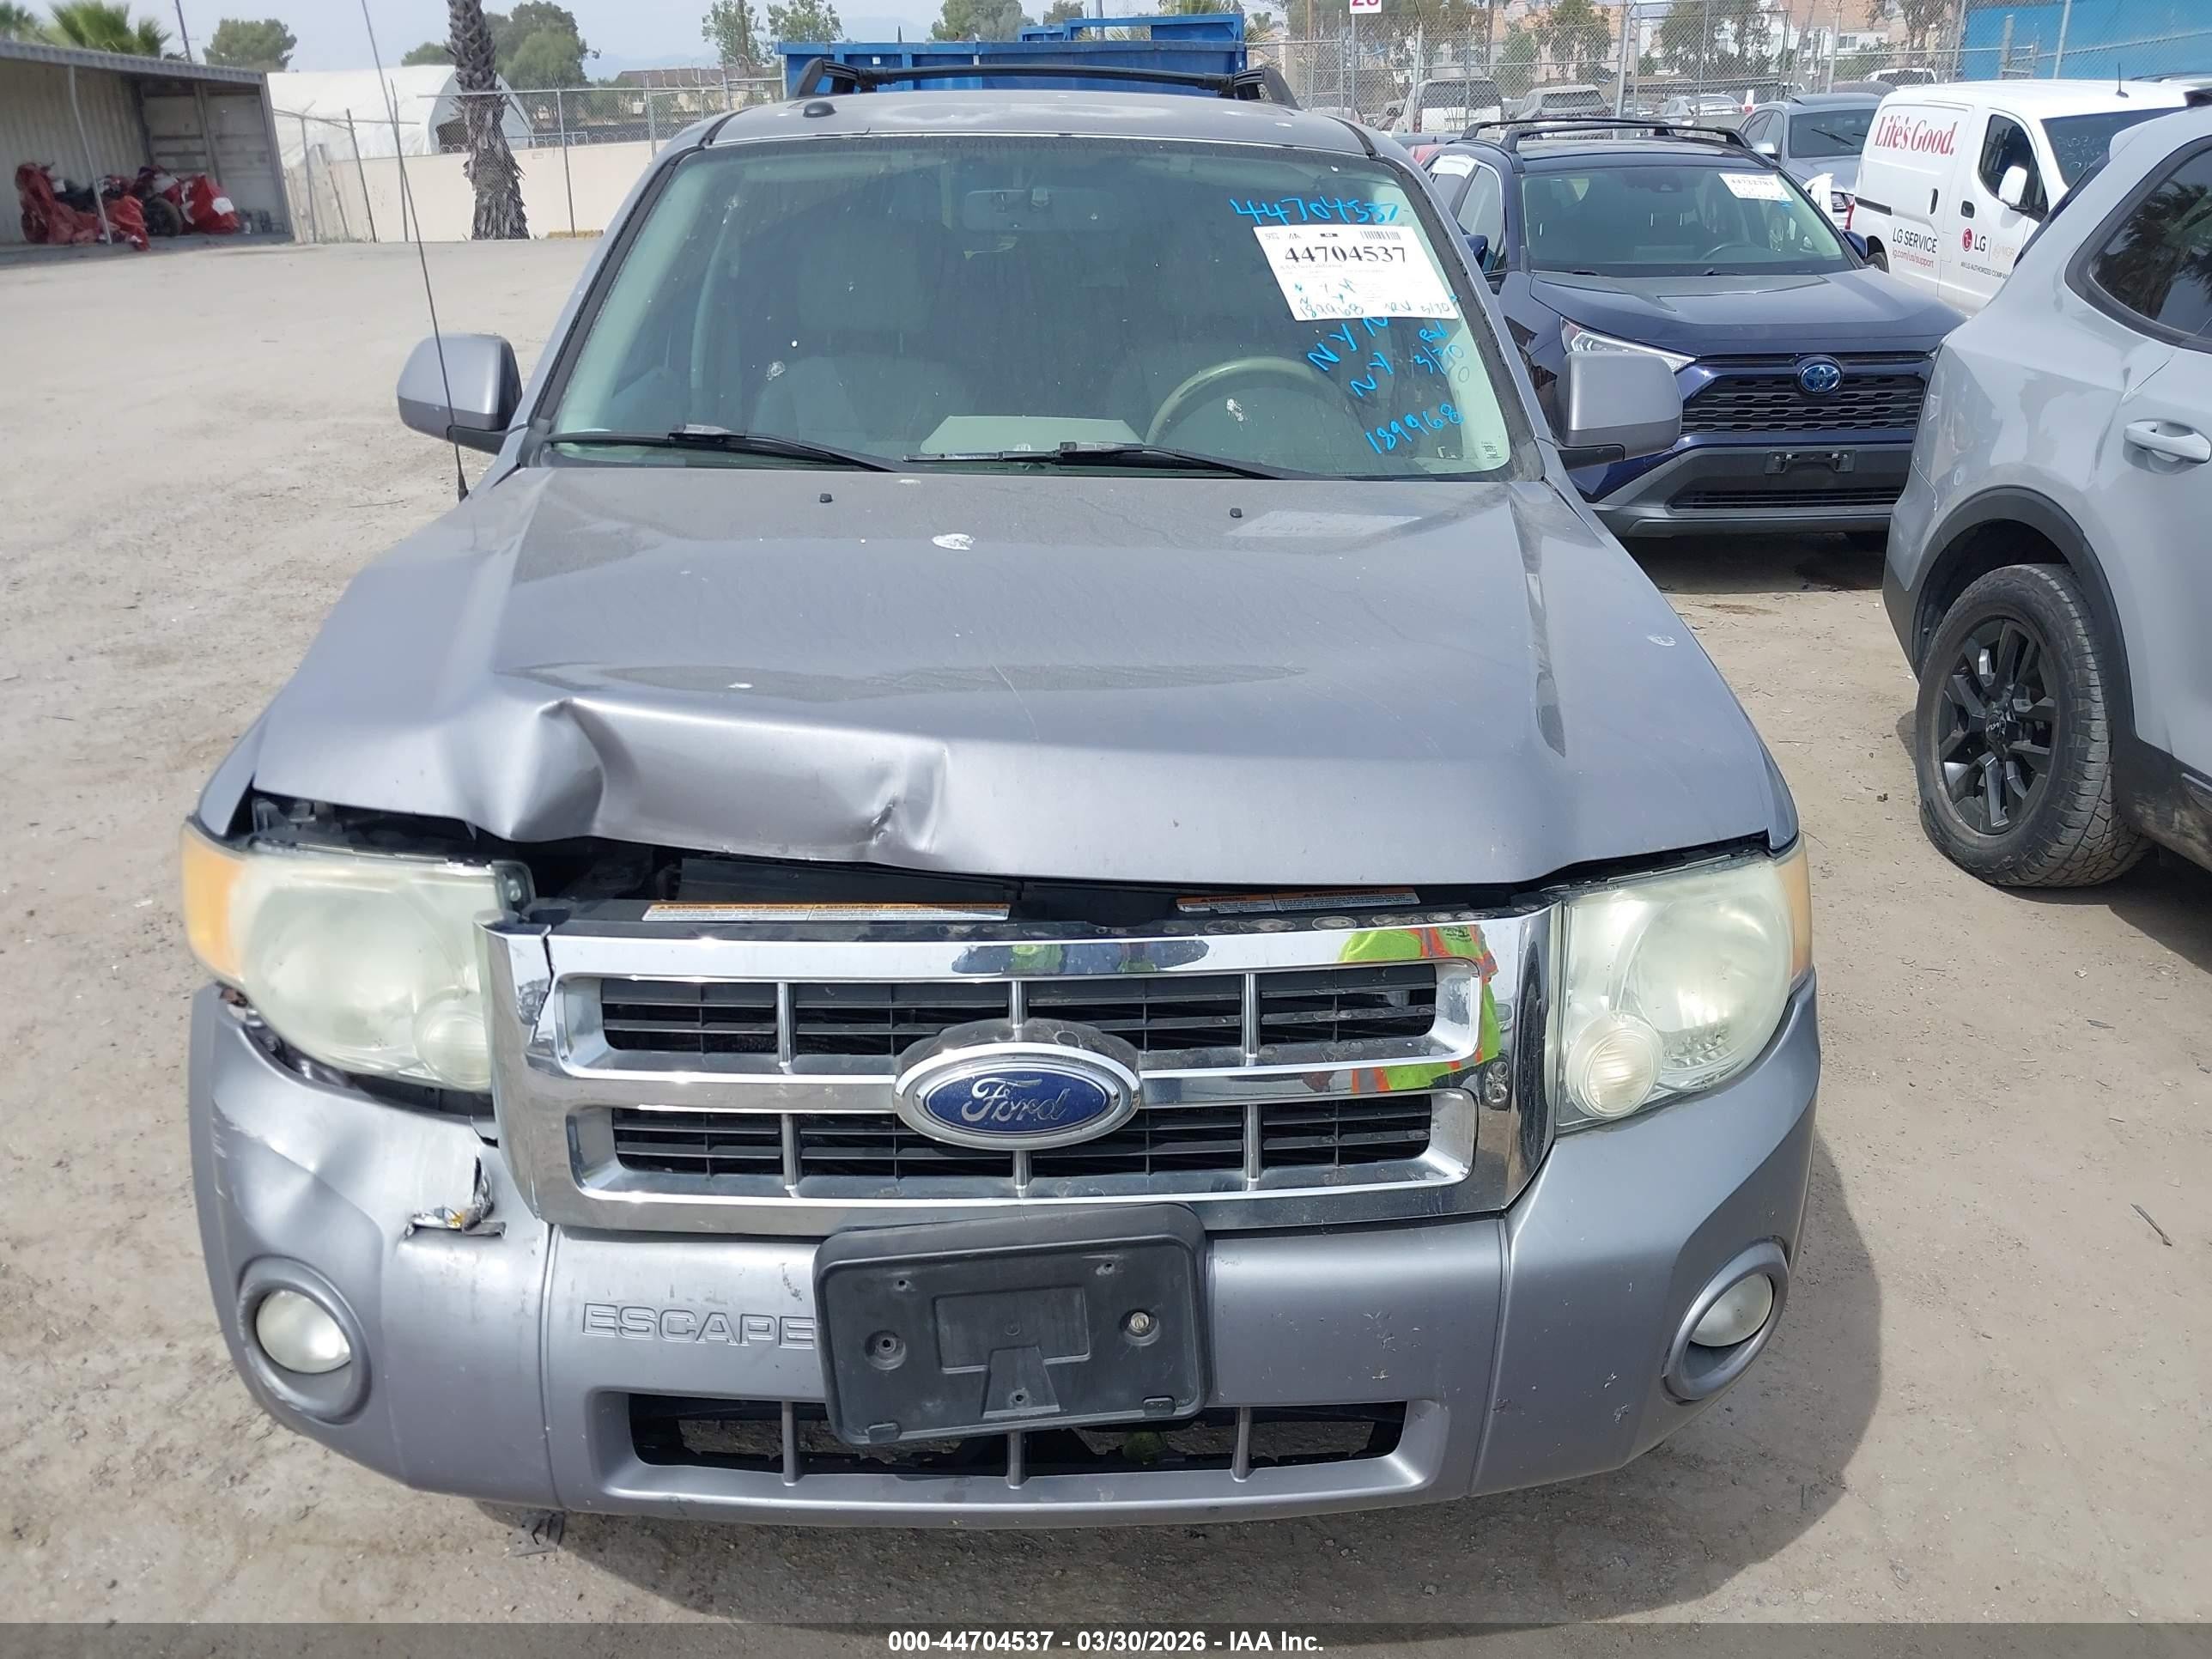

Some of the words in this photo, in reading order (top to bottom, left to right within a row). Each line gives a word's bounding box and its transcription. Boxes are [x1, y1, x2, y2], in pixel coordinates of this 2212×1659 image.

[1875, 115, 1911, 149] Life's
[1911, 119, 1958, 155] Good.
[1230, 195, 1400, 226] 44704537
[1285, 246, 1406, 263] 44704537
[1893, 228, 1903, 243] LG
[1904, 230, 1937, 254] SERVICE
[1973, 234, 1986, 252] LG
[1892, 247, 1935, 269] lg.com/us/support
[1365, 403, 1464, 454] 189968
[961, 1077, 1070, 1122] Ford
[582, 1303, 815, 1350] ESCAPE
